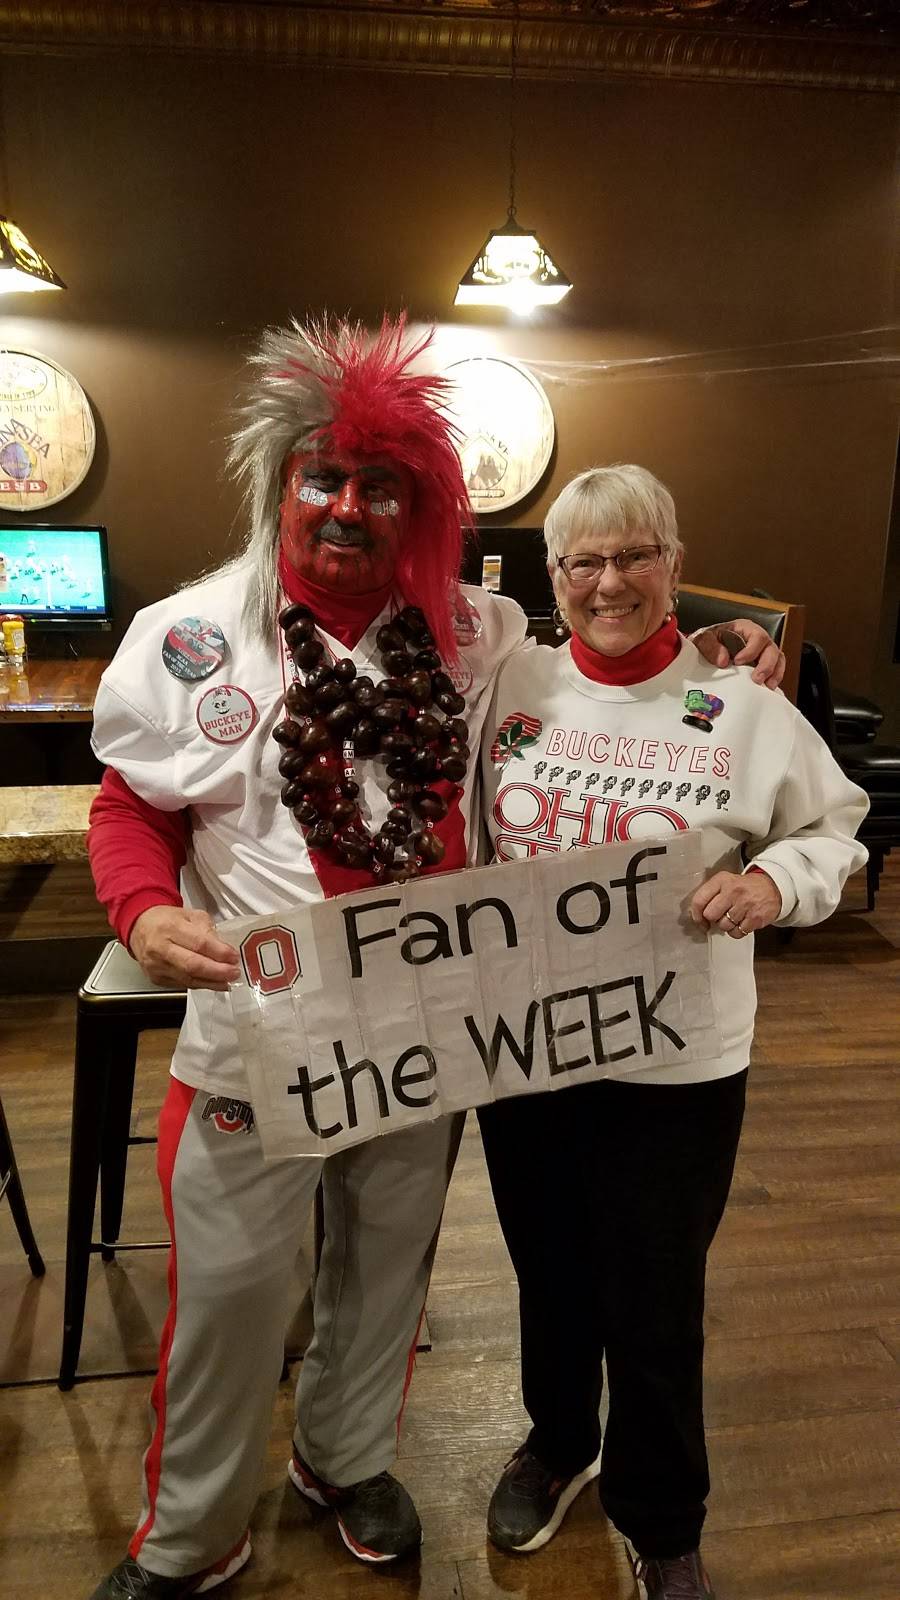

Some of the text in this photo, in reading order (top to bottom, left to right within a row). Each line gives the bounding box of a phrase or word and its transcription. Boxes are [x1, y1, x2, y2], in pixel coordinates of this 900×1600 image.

[204, 710, 251, 731] BUCKEYE
[219, 724, 243, 738] MAN
[546, 728, 731, 777] BUCKEYES
[493, 782, 690, 848] OHIO
[342, 846, 668, 978] Fan of
[239, 924, 302, 996] O
[288, 971, 687, 1139] the WEEK
